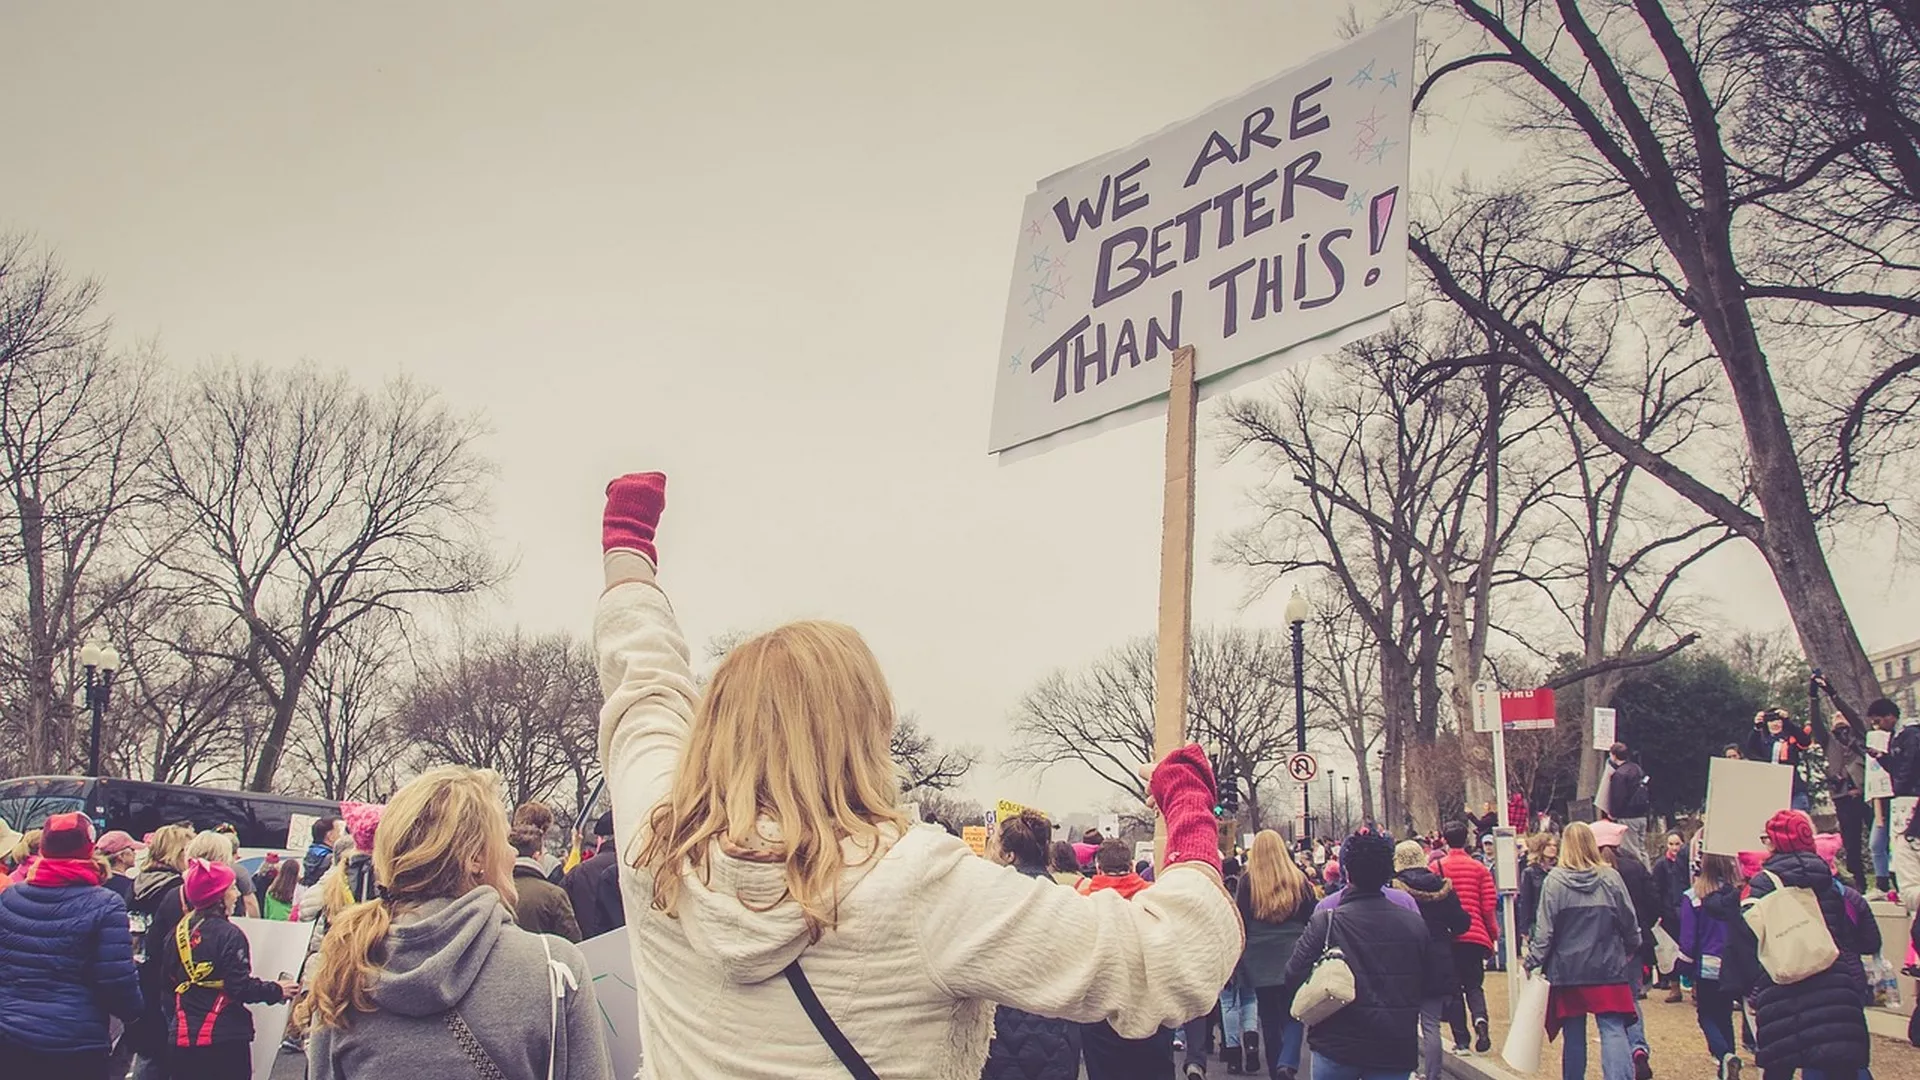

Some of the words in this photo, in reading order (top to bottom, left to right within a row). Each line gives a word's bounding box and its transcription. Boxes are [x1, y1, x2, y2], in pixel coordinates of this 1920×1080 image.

[1053, 158, 1150, 243] WE
[1183, 77, 1333, 189] ARE
[1092, 151, 1349, 309] BETTER
[1031, 290, 1182, 402] THAN
